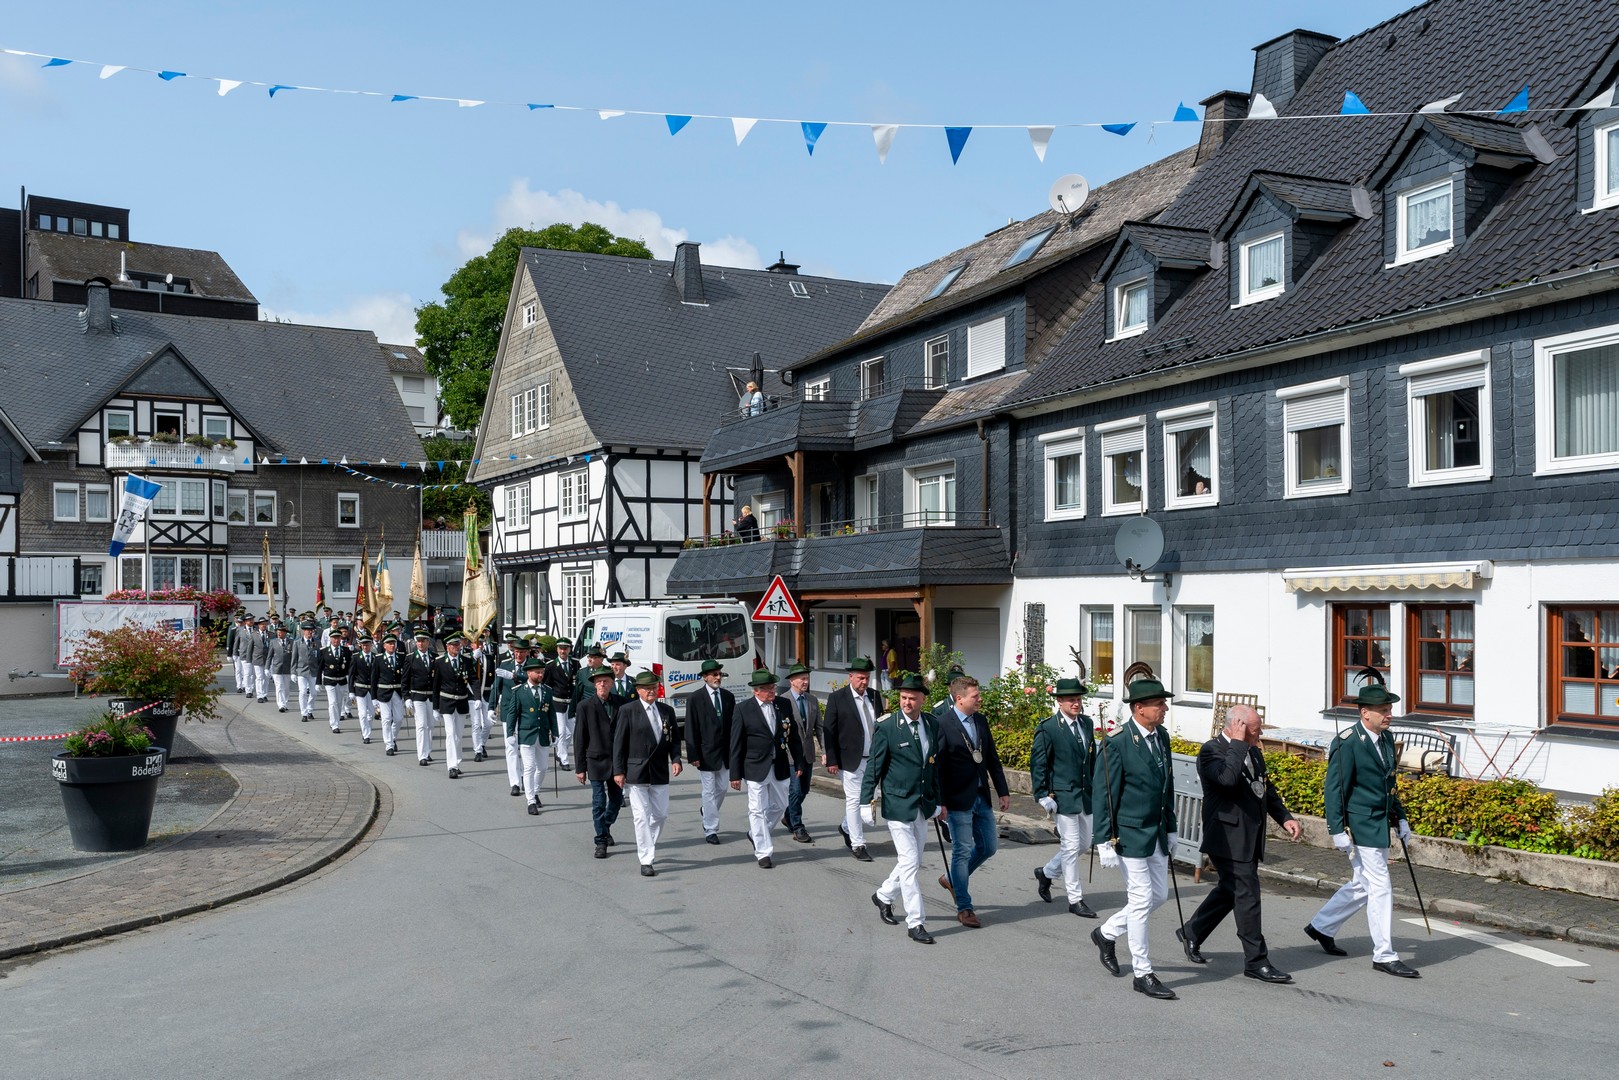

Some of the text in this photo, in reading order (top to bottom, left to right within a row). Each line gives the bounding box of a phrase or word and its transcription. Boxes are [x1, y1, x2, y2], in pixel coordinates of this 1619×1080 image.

[599, 631, 623, 642] SCHMIDT
[668, 673, 703, 682] SCHMID
[131, 763, 162, 777] Bödefeld
